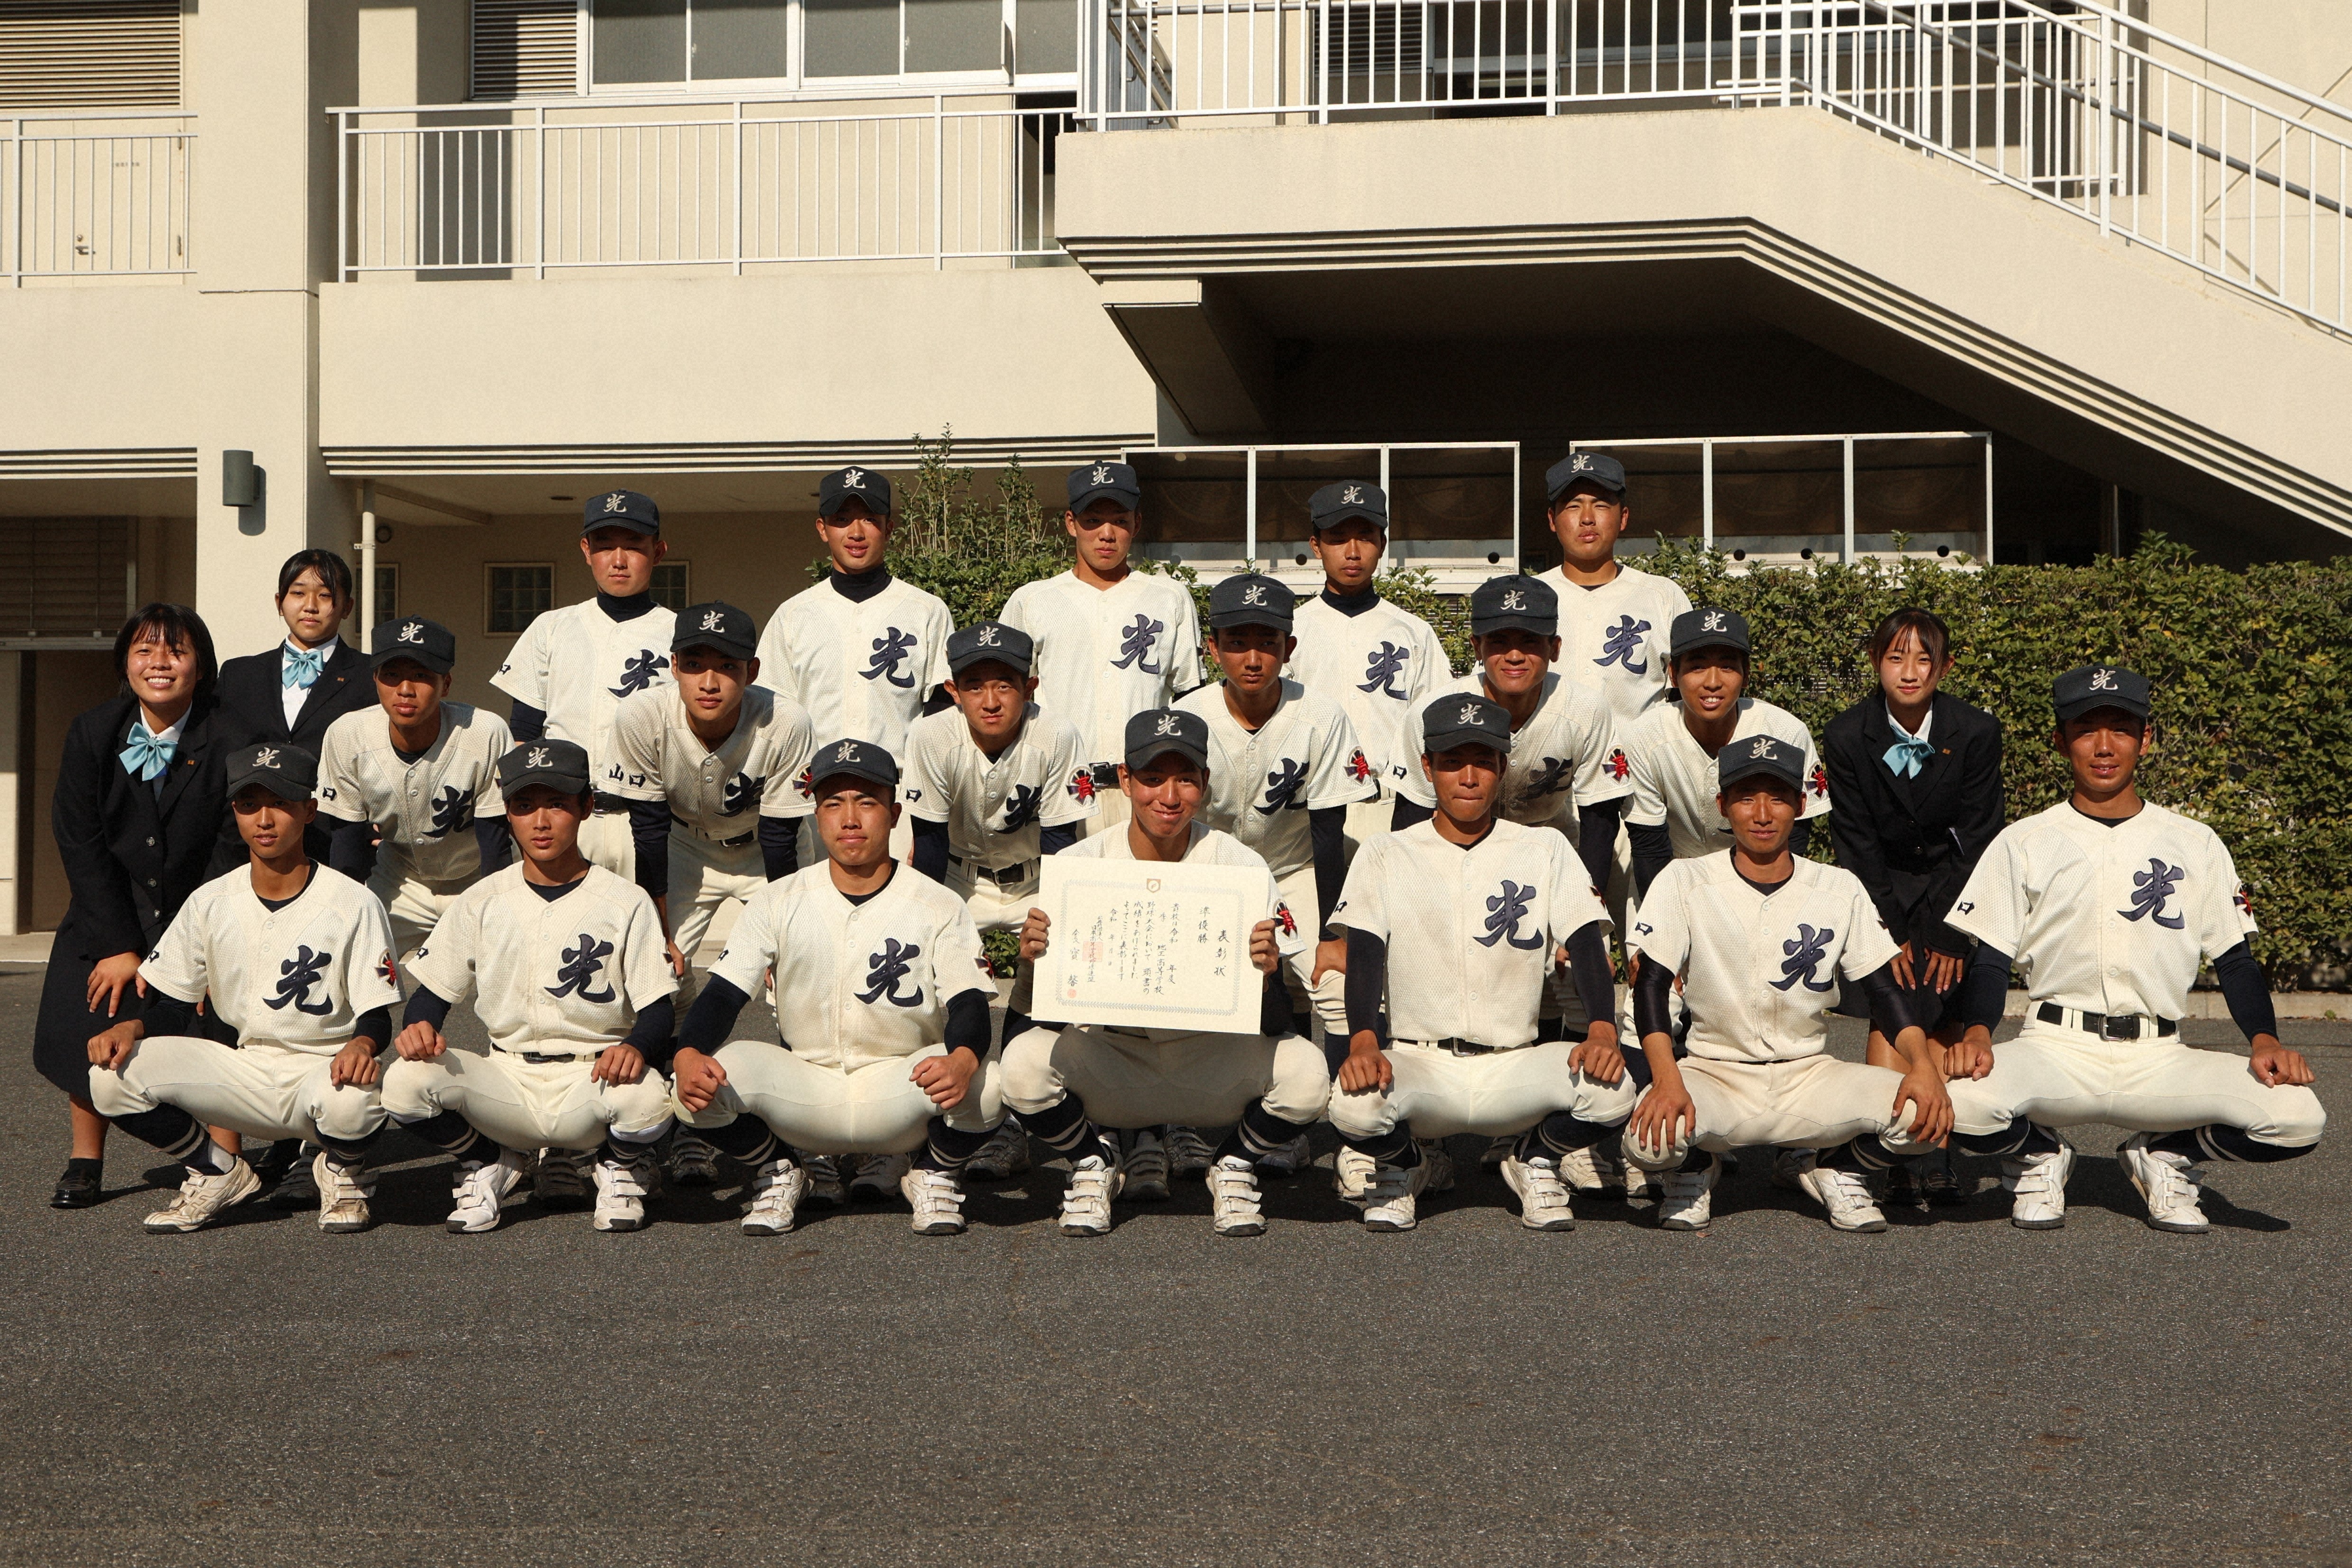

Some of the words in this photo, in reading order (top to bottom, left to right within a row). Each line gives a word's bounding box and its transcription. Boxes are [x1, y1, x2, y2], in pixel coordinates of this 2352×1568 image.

[1091, 466, 1114, 486] 光
[1571, 455, 1594, 473] 光
[843, 469, 866, 489] 光
[603, 493, 627, 513] 光
[1341, 485, 1364, 504] 光
[1241, 585, 1268, 606] 光
[1500, 589, 1528, 611] 光
[397, 622, 424, 644] 光
[698, 610, 726, 633] 光
[1700, 611, 1727, 633] 光
[977, 626, 1001, 647] 光
[1110, 614, 1163, 674] 光
[1593, 614, 1652, 674] 光
[858, 627, 917, 688] 光
[1356, 641, 1410, 700] 光
[2089, 669, 2118, 691] 光
[1154, 714, 1182, 736] 光
[1457, 703, 1484, 725] 光
[252, 747, 281, 769] 光
[526, 747, 553, 768] 光
[834, 742, 861, 763] 光
[1749, 738, 1778, 760] 光
[609, 763, 646, 788] 山口
[1353, 755, 1370, 781] 高
[1610, 754, 1628, 778] 高
[1077, 774, 1095, 799] 高
[1254, 758, 1309, 816] 光
[2116, 858, 2185, 930] 光
[1110, 908, 1118, 922] 令和
[1169, 903, 1180, 944] 貴校は令和
[1197, 906, 1210, 944] 準優勝
[1279, 910, 1295, 934] 高
[1473, 880, 1544, 950] 光
[1072, 929, 1080, 944] 会長
[1118, 900, 1130, 982] よってここに表彰します
[1132, 901, 1143, 979] 成績をあげられました
[1145, 901, 1156, 961] 野球大会において
[1214, 929, 1230, 977] 表彰状
[1768, 923, 1834, 992] 光
[263, 944, 332, 1015] 光
[544, 934, 616, 1003] 光
[854, 937, 923, 1007] 光
[1167, 964, 1177, 984] 年度
[1142, 968, 1152, 995] 頭書の
